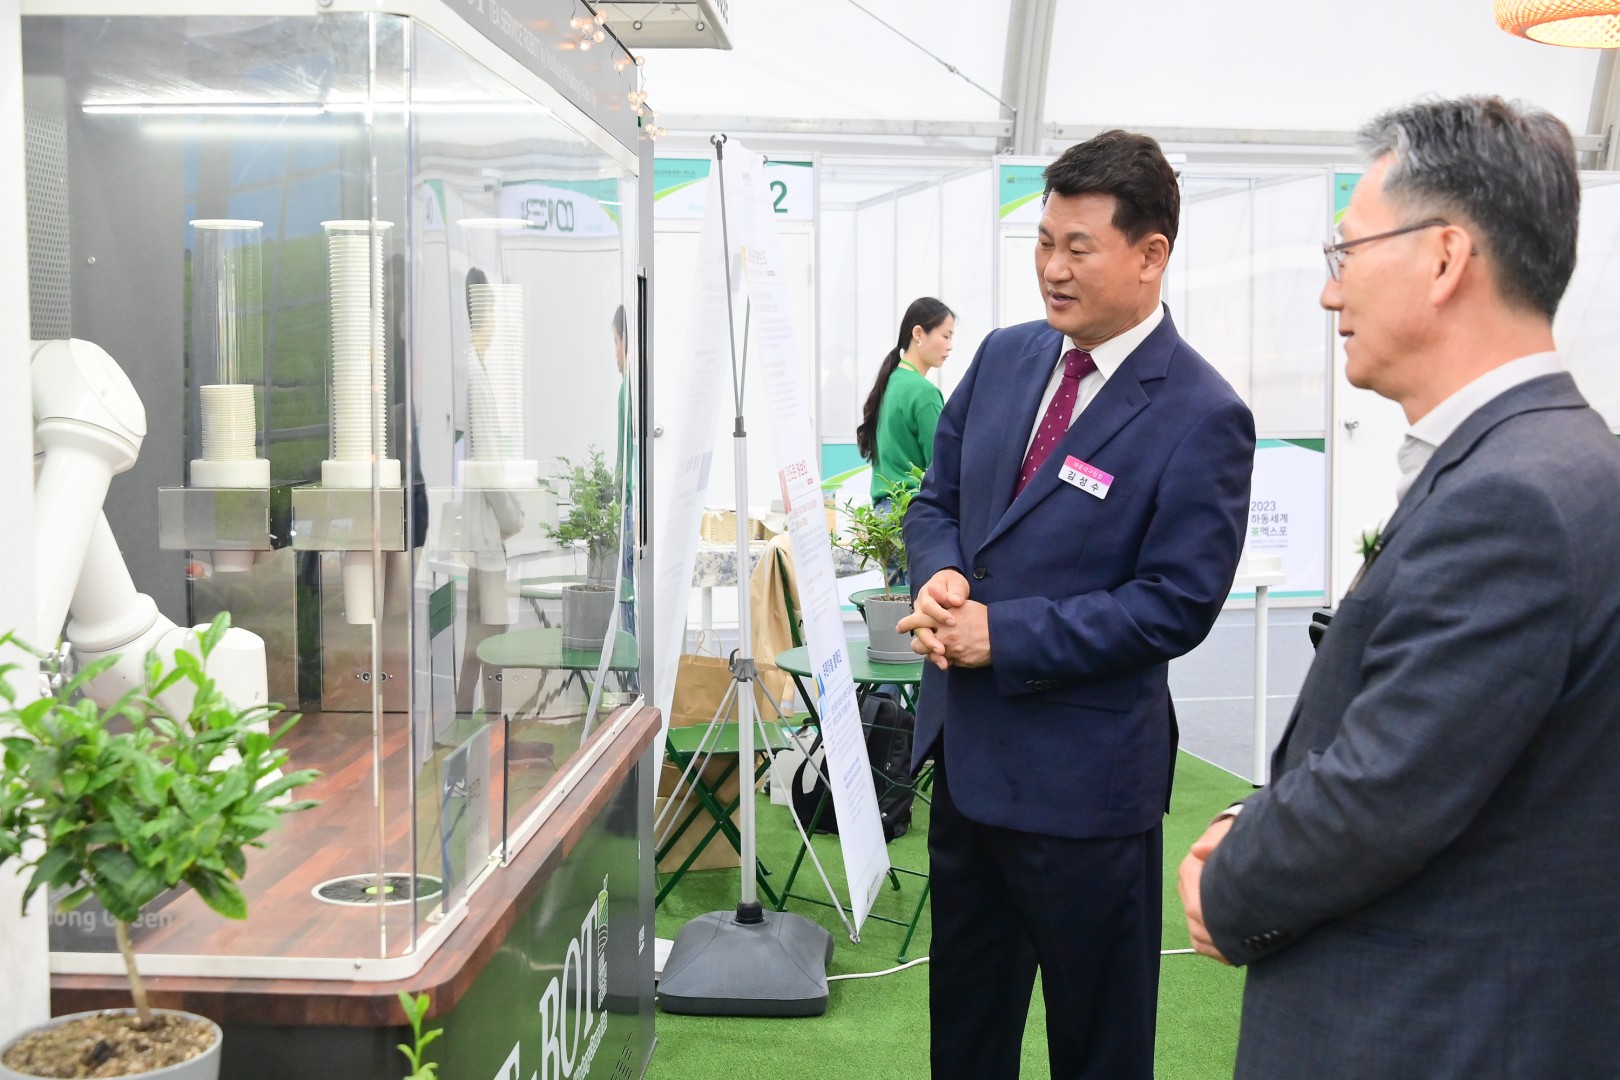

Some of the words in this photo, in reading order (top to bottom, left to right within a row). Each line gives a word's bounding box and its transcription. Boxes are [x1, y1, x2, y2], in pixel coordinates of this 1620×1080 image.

[769, 180, 788, 213] 2
[1251, 500, 1276, 512] 2023
[1251, 513, 1289, 525] 하동세계
